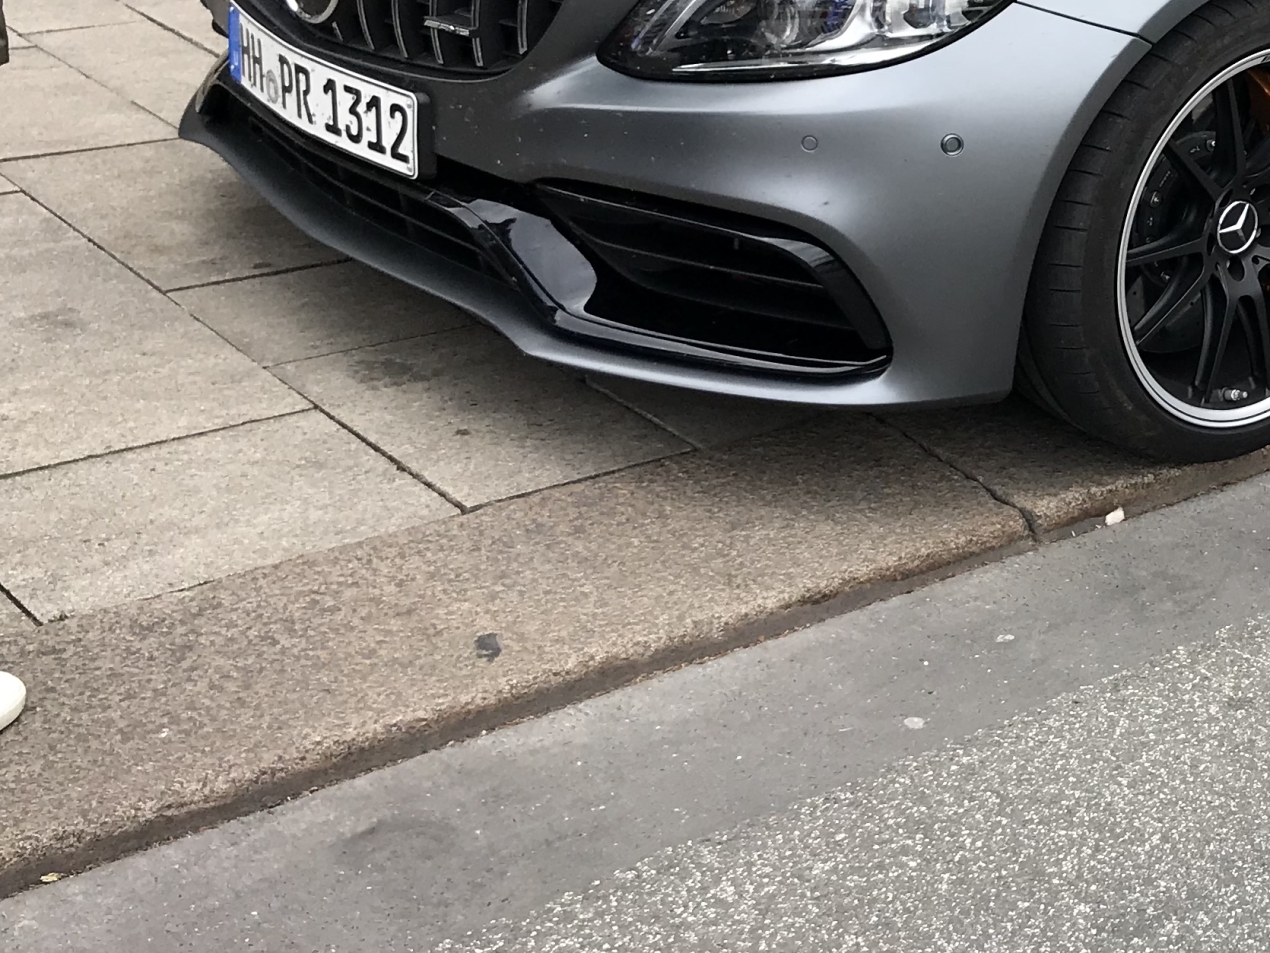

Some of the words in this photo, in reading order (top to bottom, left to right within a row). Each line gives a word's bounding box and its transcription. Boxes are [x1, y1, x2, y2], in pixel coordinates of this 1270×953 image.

[239, 22, 264, 94] HH
[278, 53, 313, 125] PR
[323, 78, 410, 164] 1312
